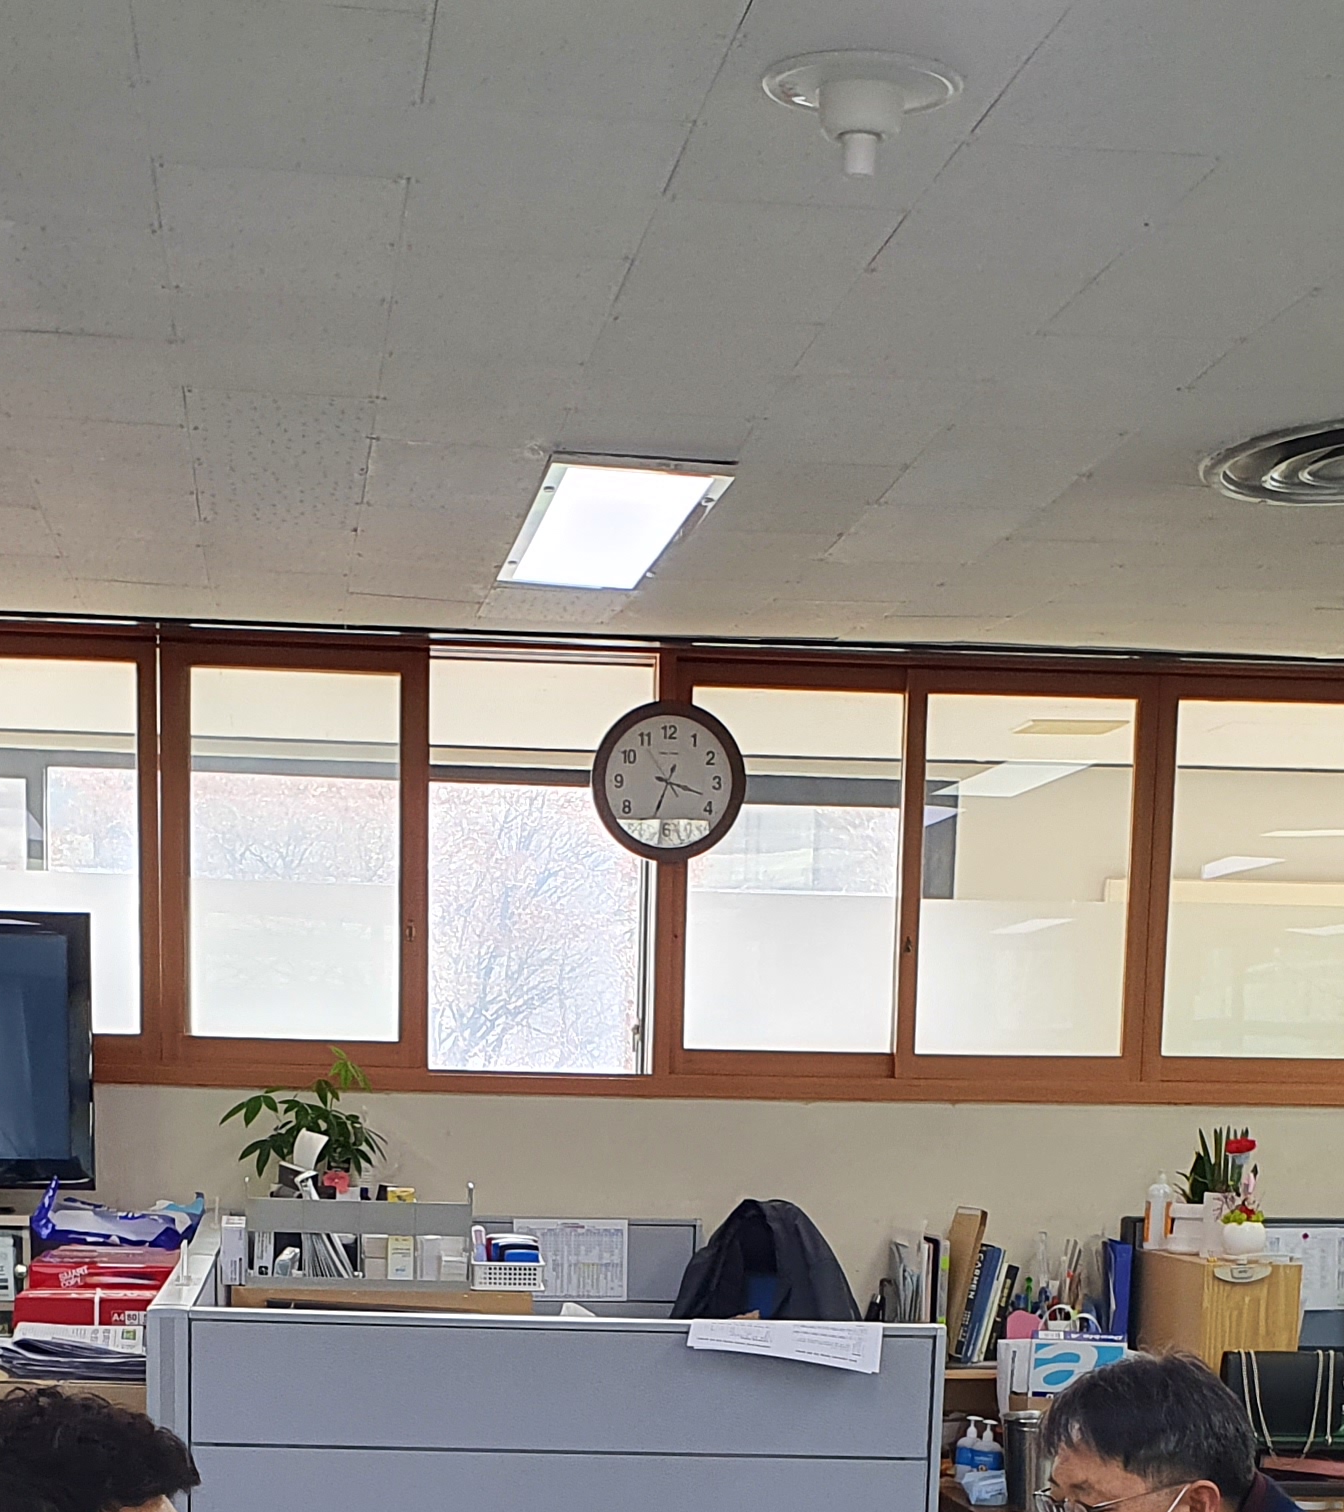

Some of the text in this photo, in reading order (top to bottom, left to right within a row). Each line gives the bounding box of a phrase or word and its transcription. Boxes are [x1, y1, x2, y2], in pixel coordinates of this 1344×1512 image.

[638, 732, 652, 747] 11
[661, 725, 677, 740] 12
[690, 733, 698, 748] 1
[621, 749, 637, 764] 10
[705, 751, 716, 766] 2
[614, 774, 624, 788] 9
[711, 775, 722, 790] 3
[622, 799, 632, 814] 8
[703, 801, 713, 815] 4
[662, 823, 671, 837] 6
[968, 1253, 985, 1299] CARMEN
[112, 1312, 125, 1322] A4
